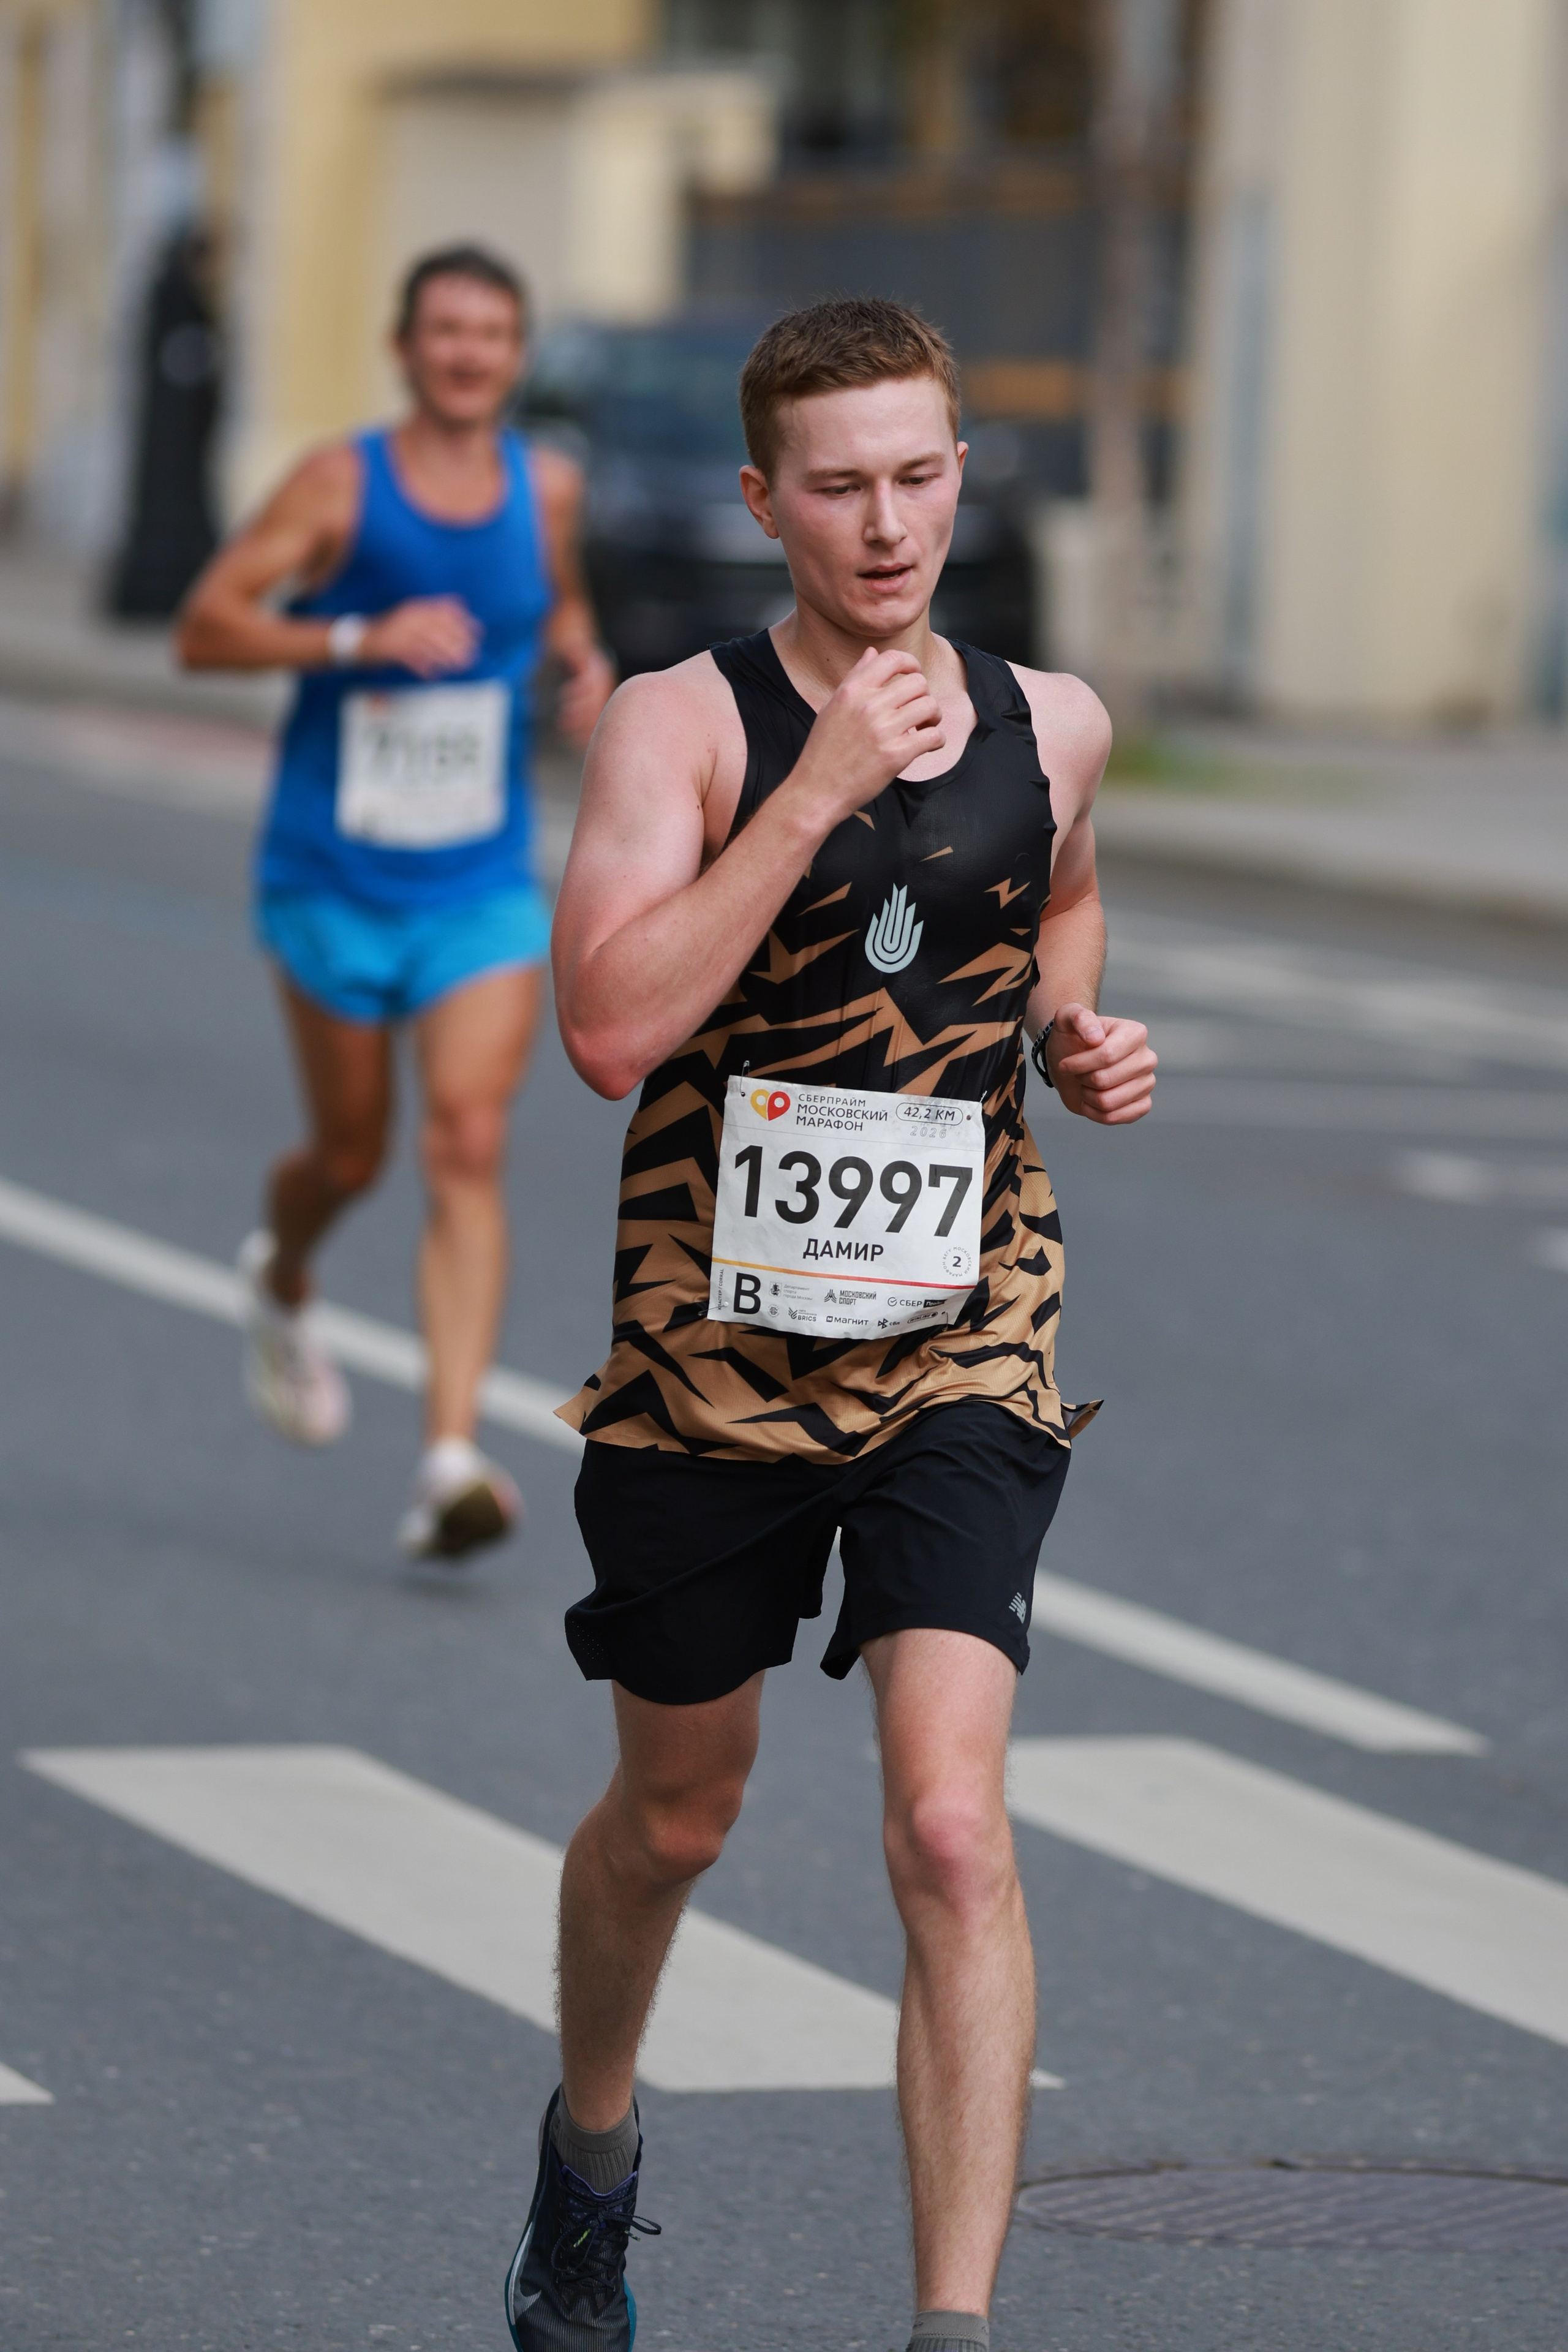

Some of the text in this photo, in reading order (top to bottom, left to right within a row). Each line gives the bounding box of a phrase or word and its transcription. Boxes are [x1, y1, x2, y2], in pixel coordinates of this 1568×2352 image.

[798, 1093, 866, 1107] СБЕРПРАЙМ
[797, 1104, 888, 1121] МОСКОВСКИЙ
[903, 1107, 956, 1121] 42,2 КМ
[796, 1115, 863, 1131] МАРАФОН
[910, 1126, 947, 1139] 2026
[735, 1145, 973, 1237] 13997
[802, 1238, 884, 1262] ДАМИР
[952, 1256, 962, 1267] 2
[839, 1289, 877, 1300] МОСКОВСКИЙ
[834, 1317, 869, 1325] магнит
